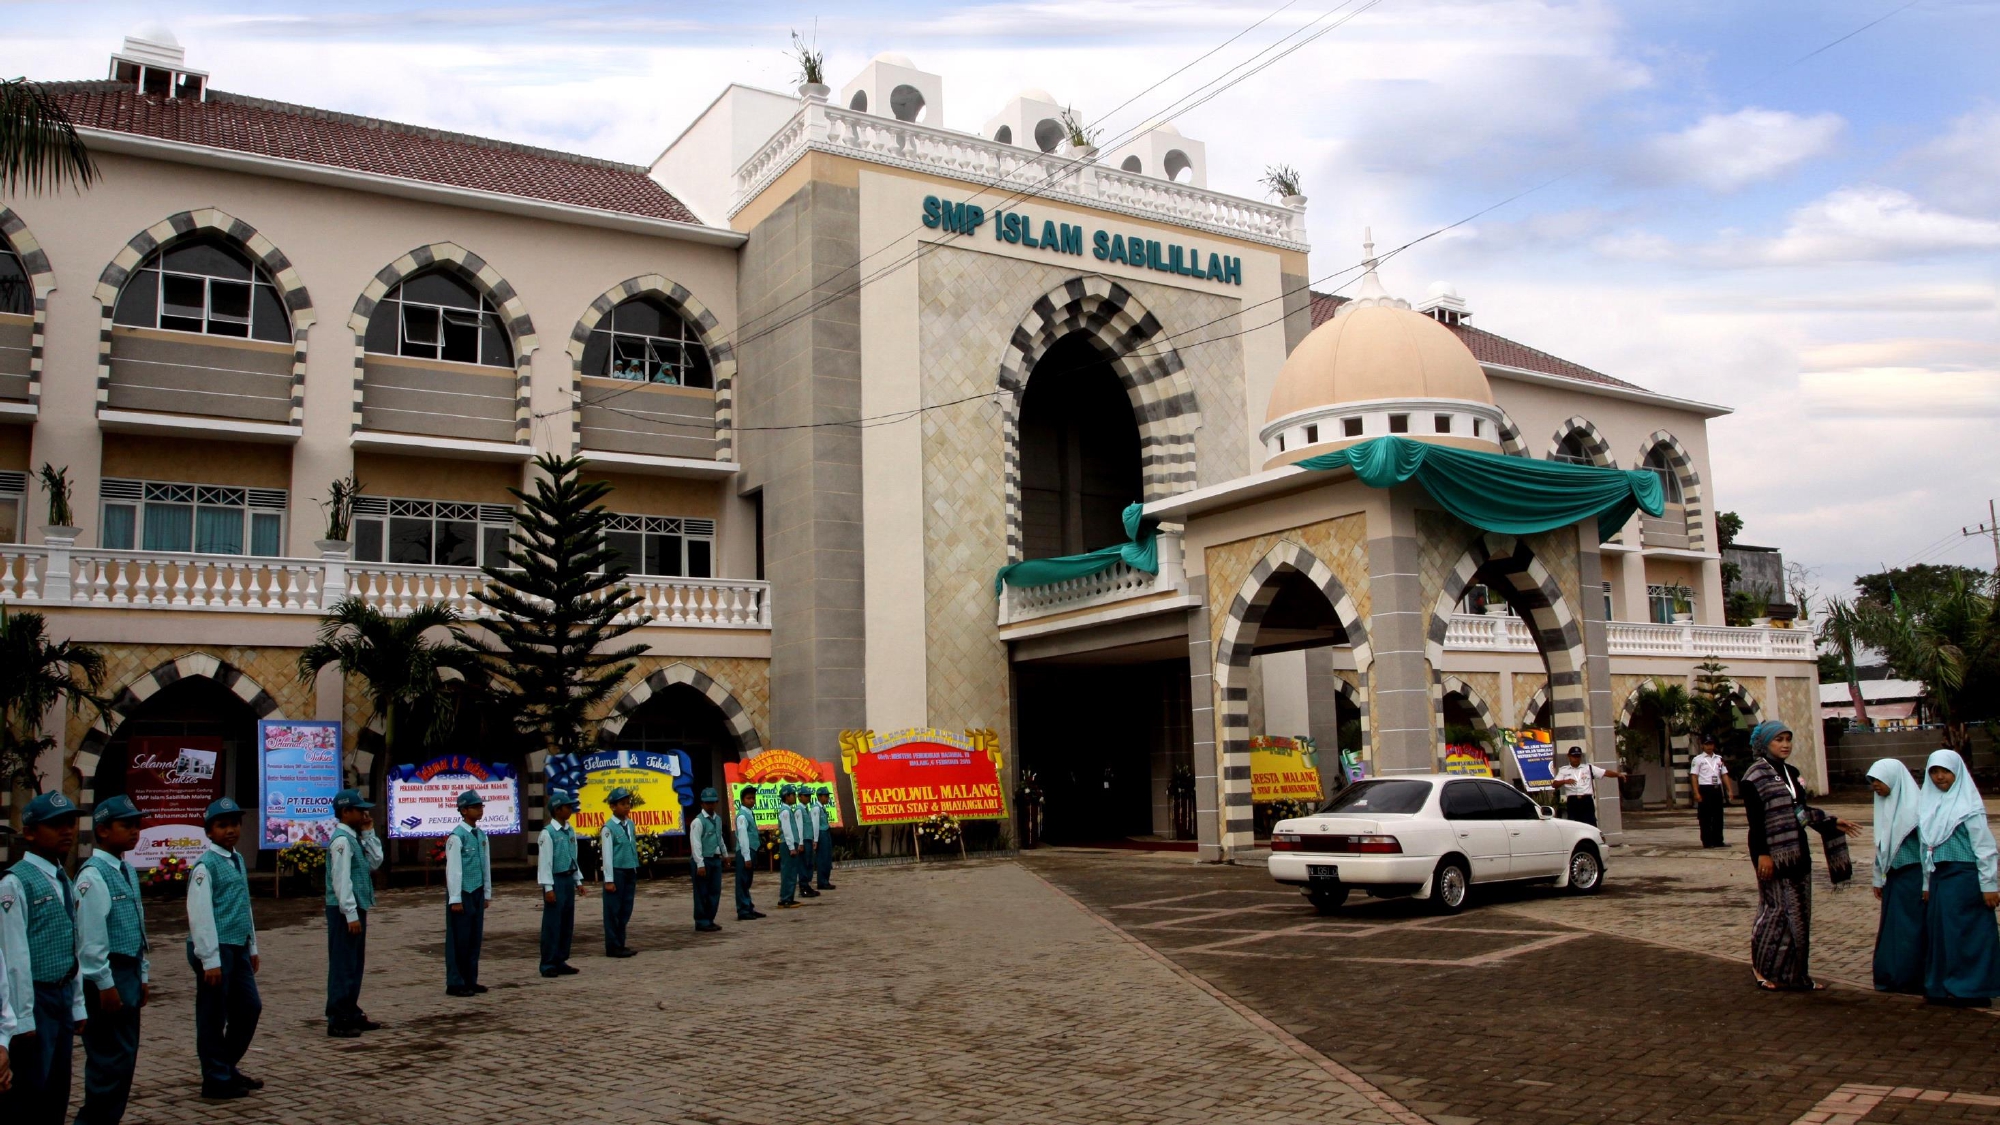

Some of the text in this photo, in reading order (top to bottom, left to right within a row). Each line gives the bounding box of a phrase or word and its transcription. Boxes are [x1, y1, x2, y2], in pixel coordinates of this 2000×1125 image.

[922, 194, 1242, 286] SMP ISLAM SABILILLAH
[132, 753, 180, 769] Selamat
[630, 753, 639, 766] &
[164, 769, 199, 785] Sukses
[1282, 772, 1317, 783] MALANG
[191, 793, 212, 801] Malang
[860, 784, 998, 804] KAPOLWIL MALANG
[866, 799, 998, 815] BESERTA STAF & BHAYANGKARI
[575, 812, 605, 828] DINAS
[152, 837, 202, 848] artistika
